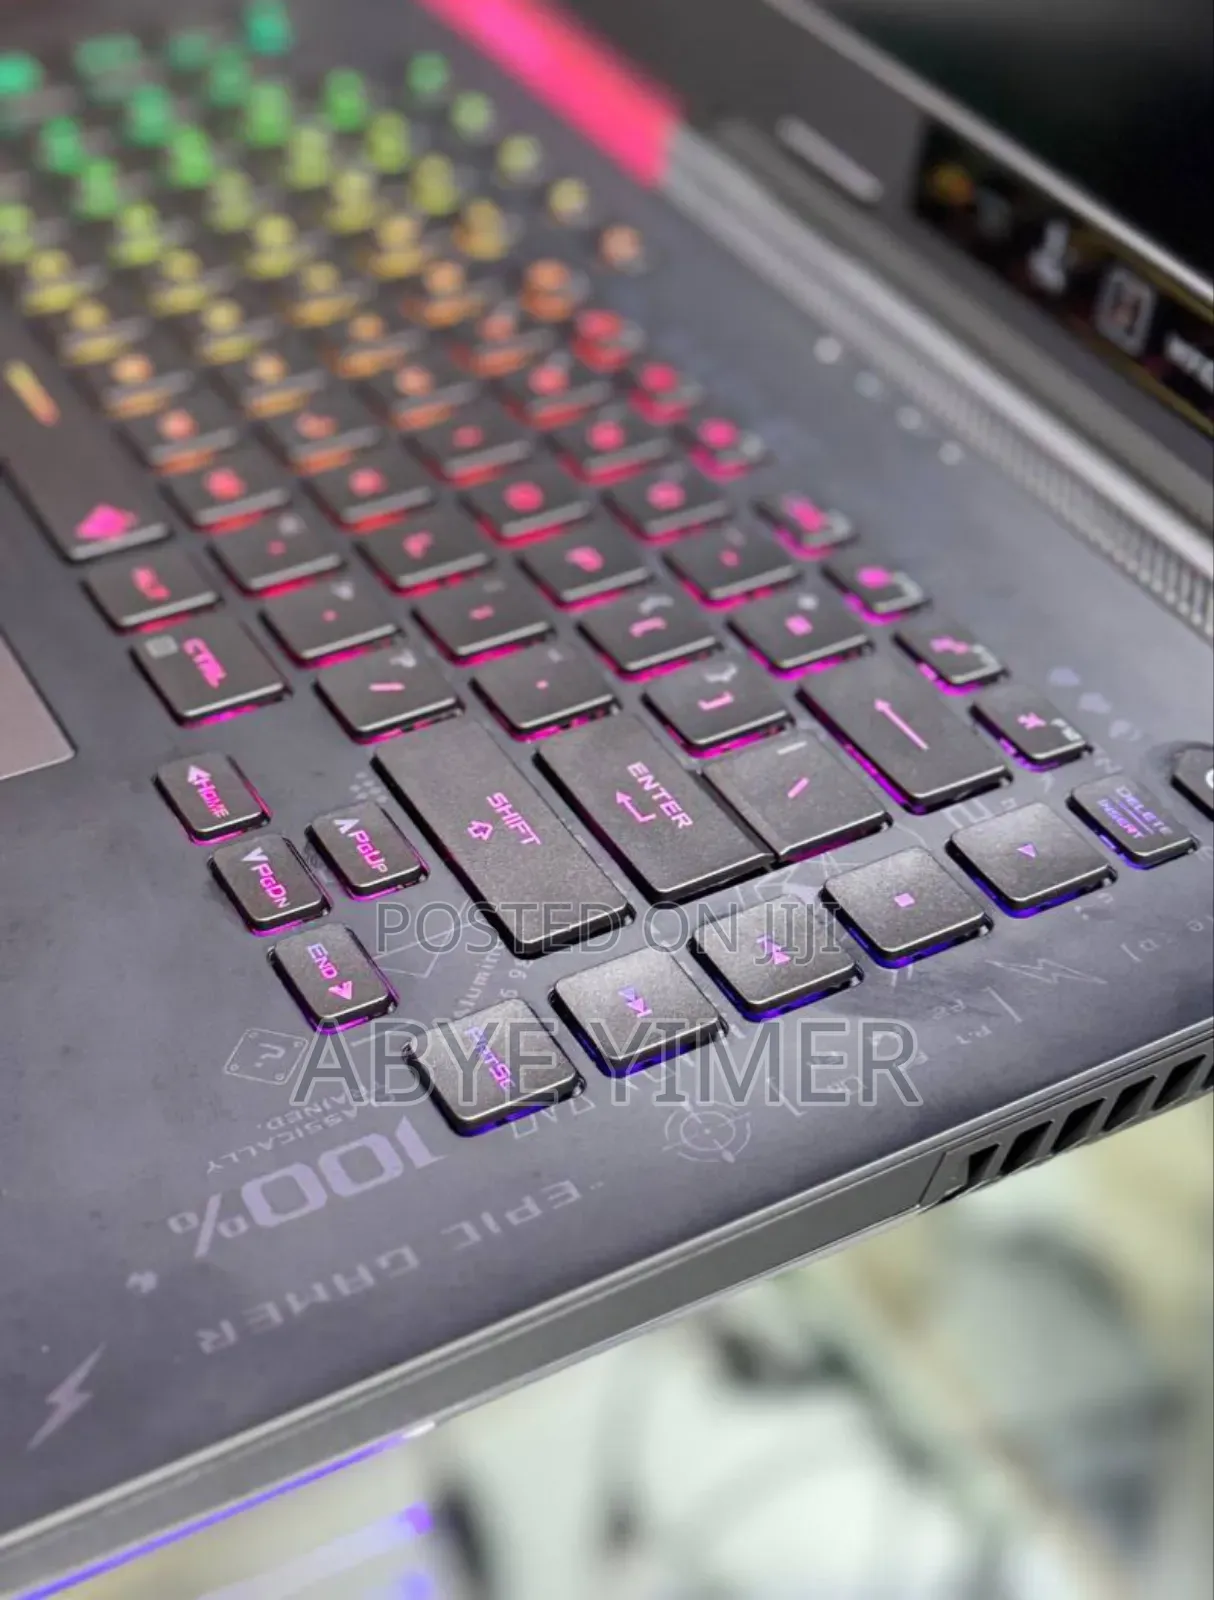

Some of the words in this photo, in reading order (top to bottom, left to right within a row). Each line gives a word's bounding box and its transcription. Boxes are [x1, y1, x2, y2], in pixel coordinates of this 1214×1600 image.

[486, 791, 543, 846] SHIFT
[626, 761, 694, 830] ENTER
[306, 942, 338, 979] END
[167, 1115, 448, 1259] 100%
[196, 1244, 420, 1355] GAMER
